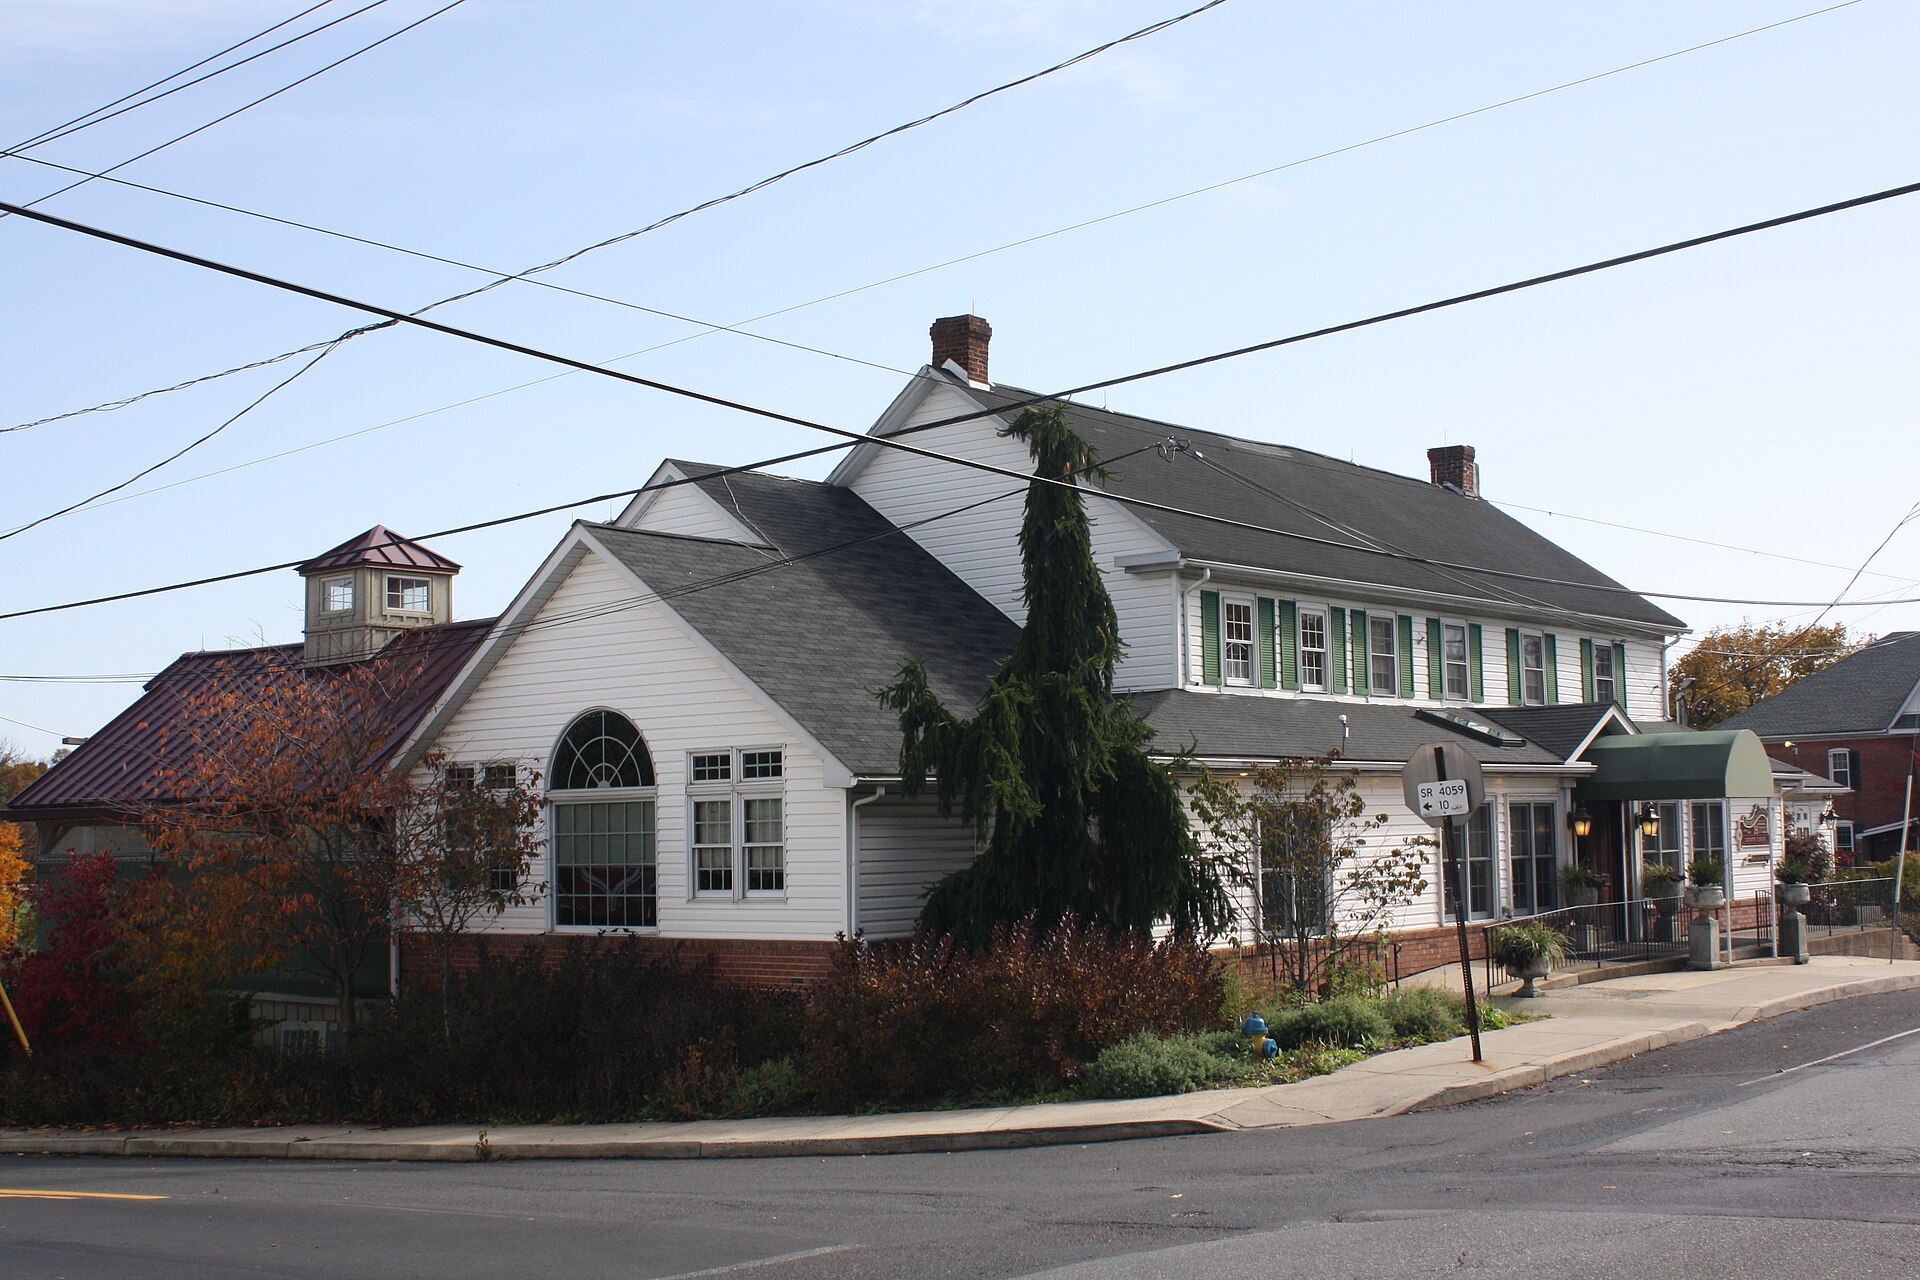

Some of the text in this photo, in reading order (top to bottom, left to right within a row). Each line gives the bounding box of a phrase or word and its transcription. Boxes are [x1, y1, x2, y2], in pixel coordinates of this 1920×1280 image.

[1420, 785, 1464, 798] SR 4059
[1439, 800, 1449, 810] 10
